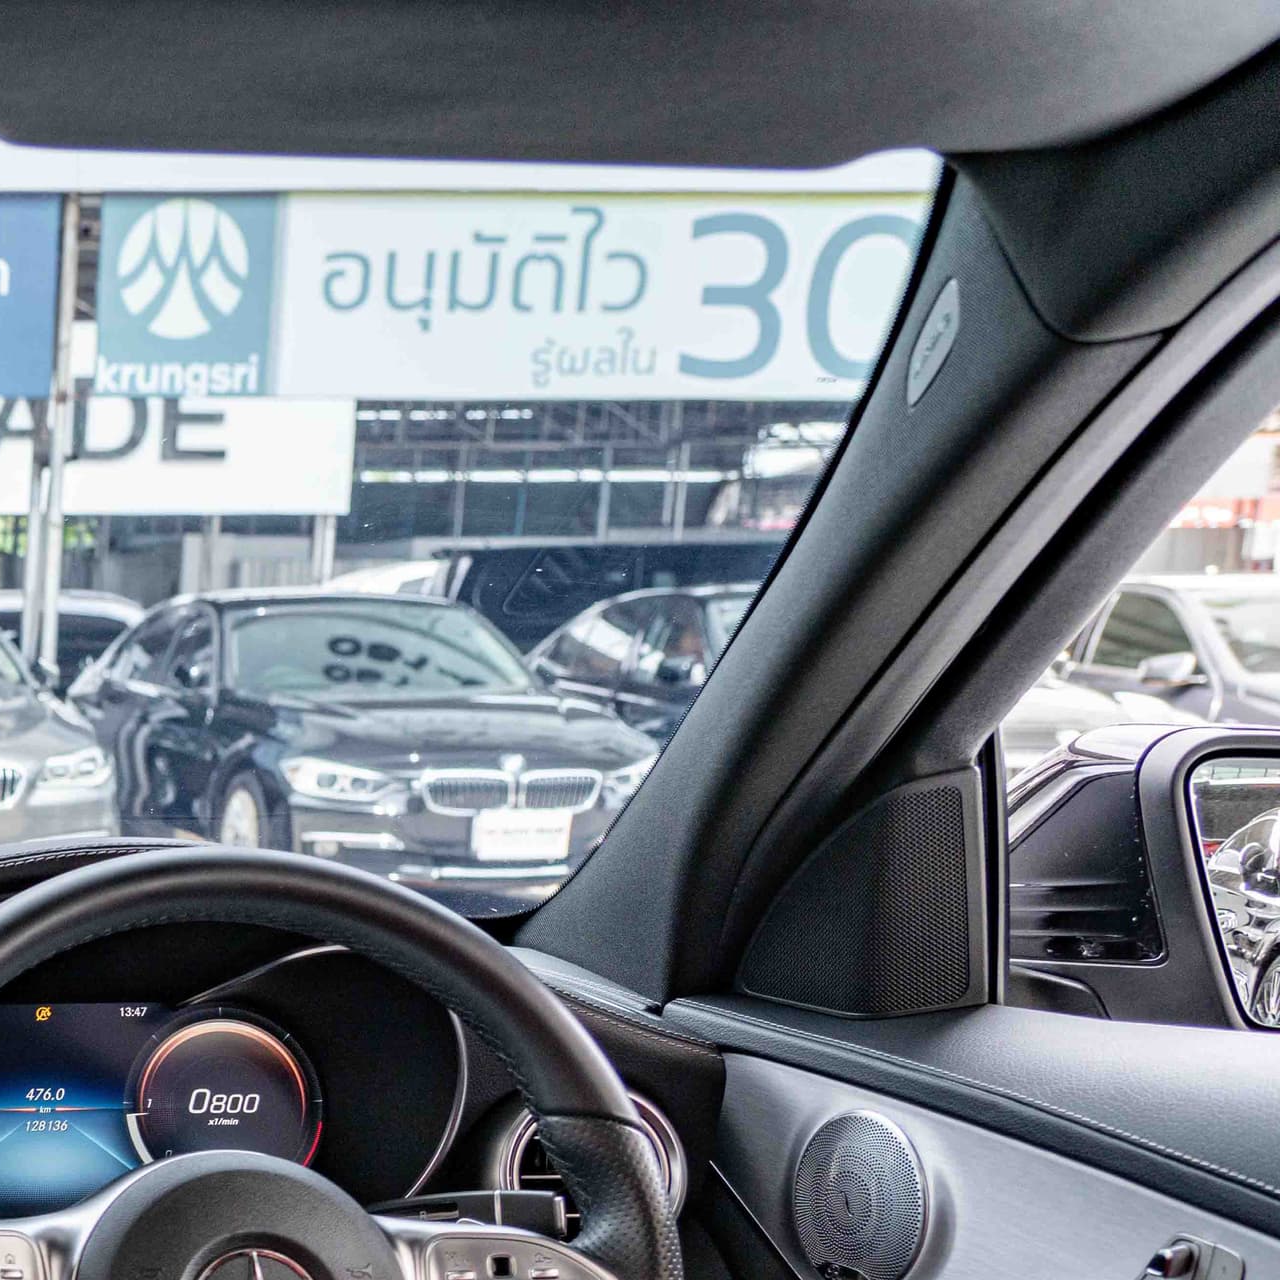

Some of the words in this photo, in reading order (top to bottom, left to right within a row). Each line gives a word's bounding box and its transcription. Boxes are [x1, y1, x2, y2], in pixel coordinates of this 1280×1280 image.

[323, 206, 650, 331] อนุมัติไว
[678, 212, 922, 380] 30
[529, 325, 657, 388] รู้ผลใน
[96, 354, 259, 397] krungsri
[119, 1006, 148, 1018] 13:47
[25, 1087, 65, 1102] 476.0
[188, 1088, 260, 1115] 0800
[39, 1104, 52, 1114] km
[207, 1117, 240, 1127] x1/min
